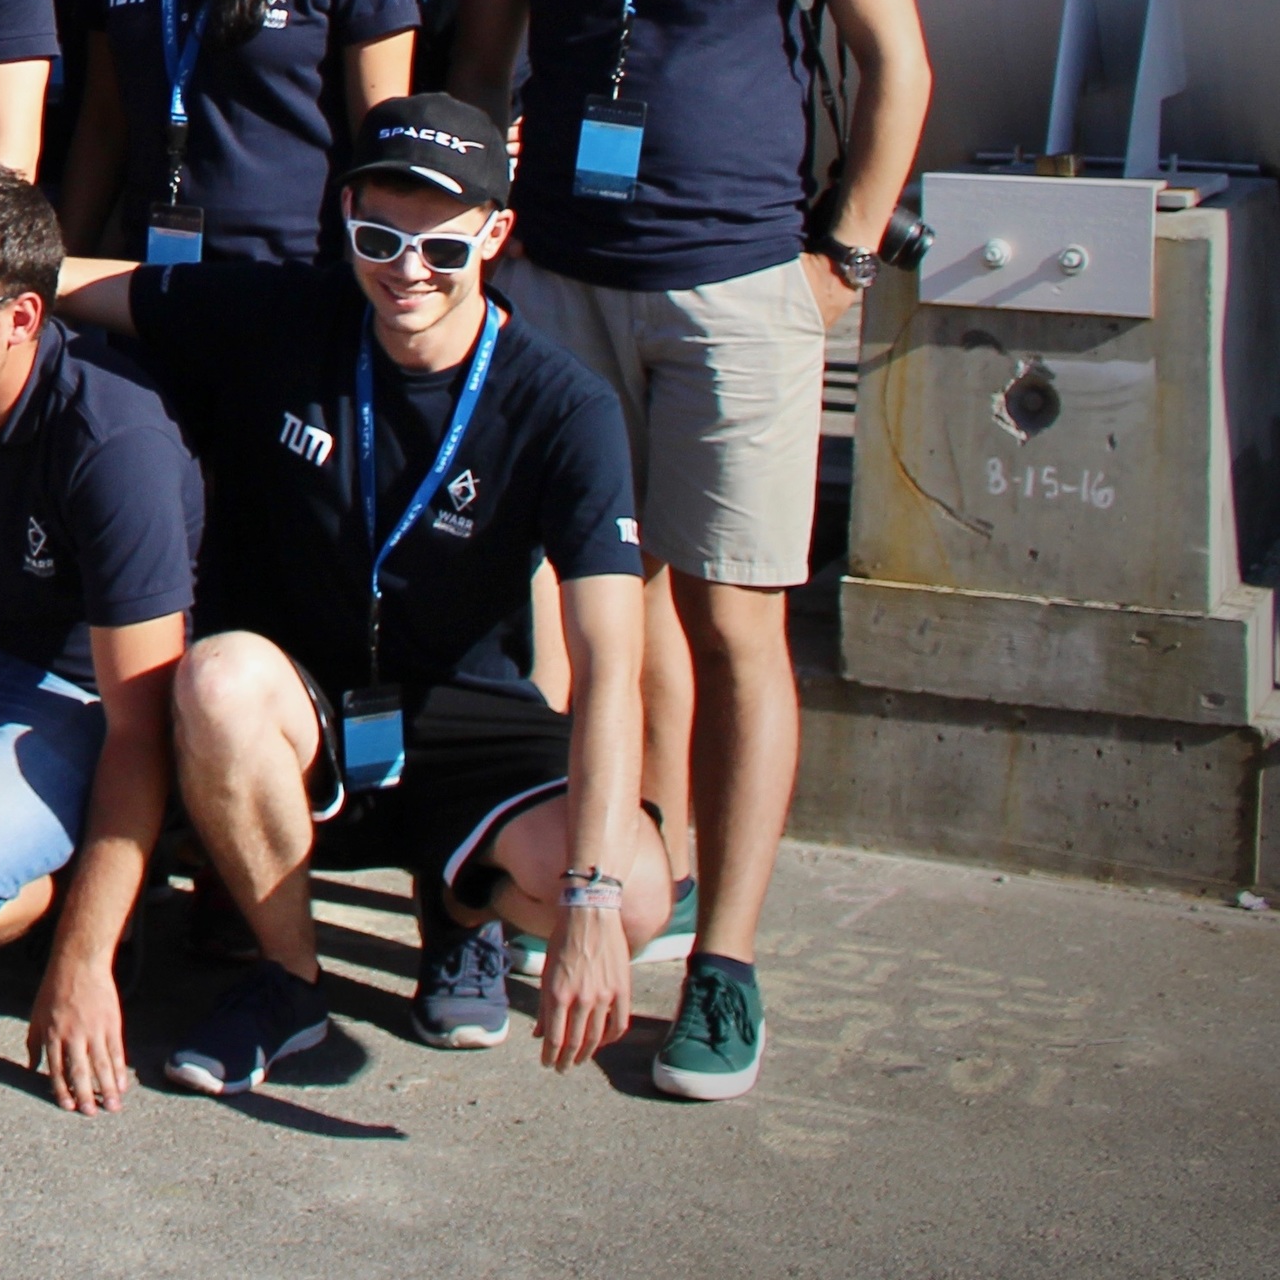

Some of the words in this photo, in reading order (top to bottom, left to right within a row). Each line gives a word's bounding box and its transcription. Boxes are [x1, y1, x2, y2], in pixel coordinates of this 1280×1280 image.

[379, 126, 484, 153] SPACEX
[469, 340, 492, 392] SPACEX
[279, 410, 334, 467] TUM
[435, 425, 463, 473] SPACEX
[987, 457, 1115, 509] 8-15-16
[389, 503, 423, 547] SPACEX
[438, 510, 474, 530] WARR
